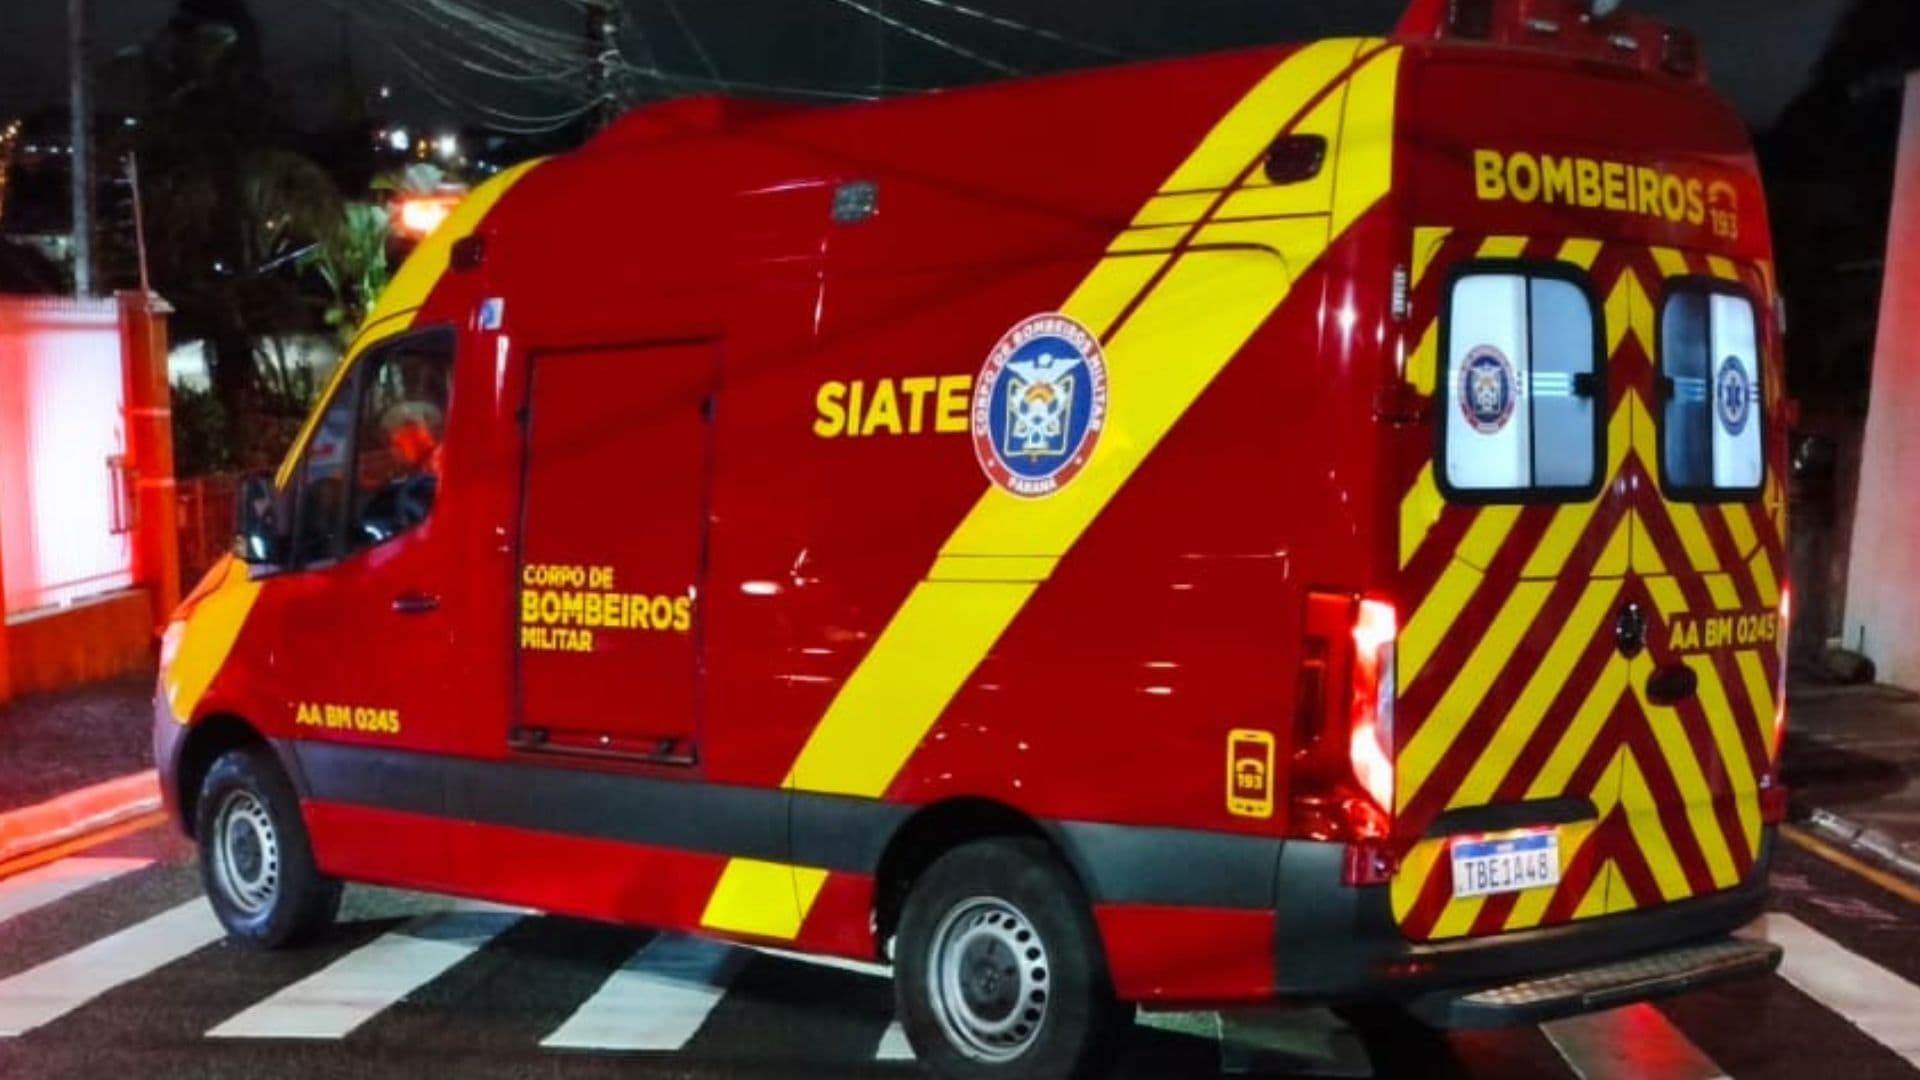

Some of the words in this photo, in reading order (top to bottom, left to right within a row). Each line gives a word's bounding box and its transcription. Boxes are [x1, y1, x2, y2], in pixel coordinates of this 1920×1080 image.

[1474, 149, 1705, 225] BOMBEIROS
[1711, 208, 1738, 240] 193
[975, 369, 994, 436] CORPO
[993, 340, 1012, 366] DE
[1012, 320, 1092, 355] BOMBEIROS
[1089, 353, 1105, 431] MILITAR
[813, 375, 972, 438] SIATE
[522, 564, 586, 588] CORPO
[589, 565, 614, 589] DE
[522, 589, 692, 631] BOMBEIROS
[521, 626, 593, 652] MILITAR
[1669, 620, 1699, 650] AA
[1705, 616, 1734, 647] BM
[1737, 612, 1775, 643] 0245
[295, 701, 322, 726] AA
[325, 704, 352, 730] BM
[354, 707, 401, 733] 0245
[1238, 773, 1263, 790] 193
[1464, 851, 1549, 891] TBE1A48
